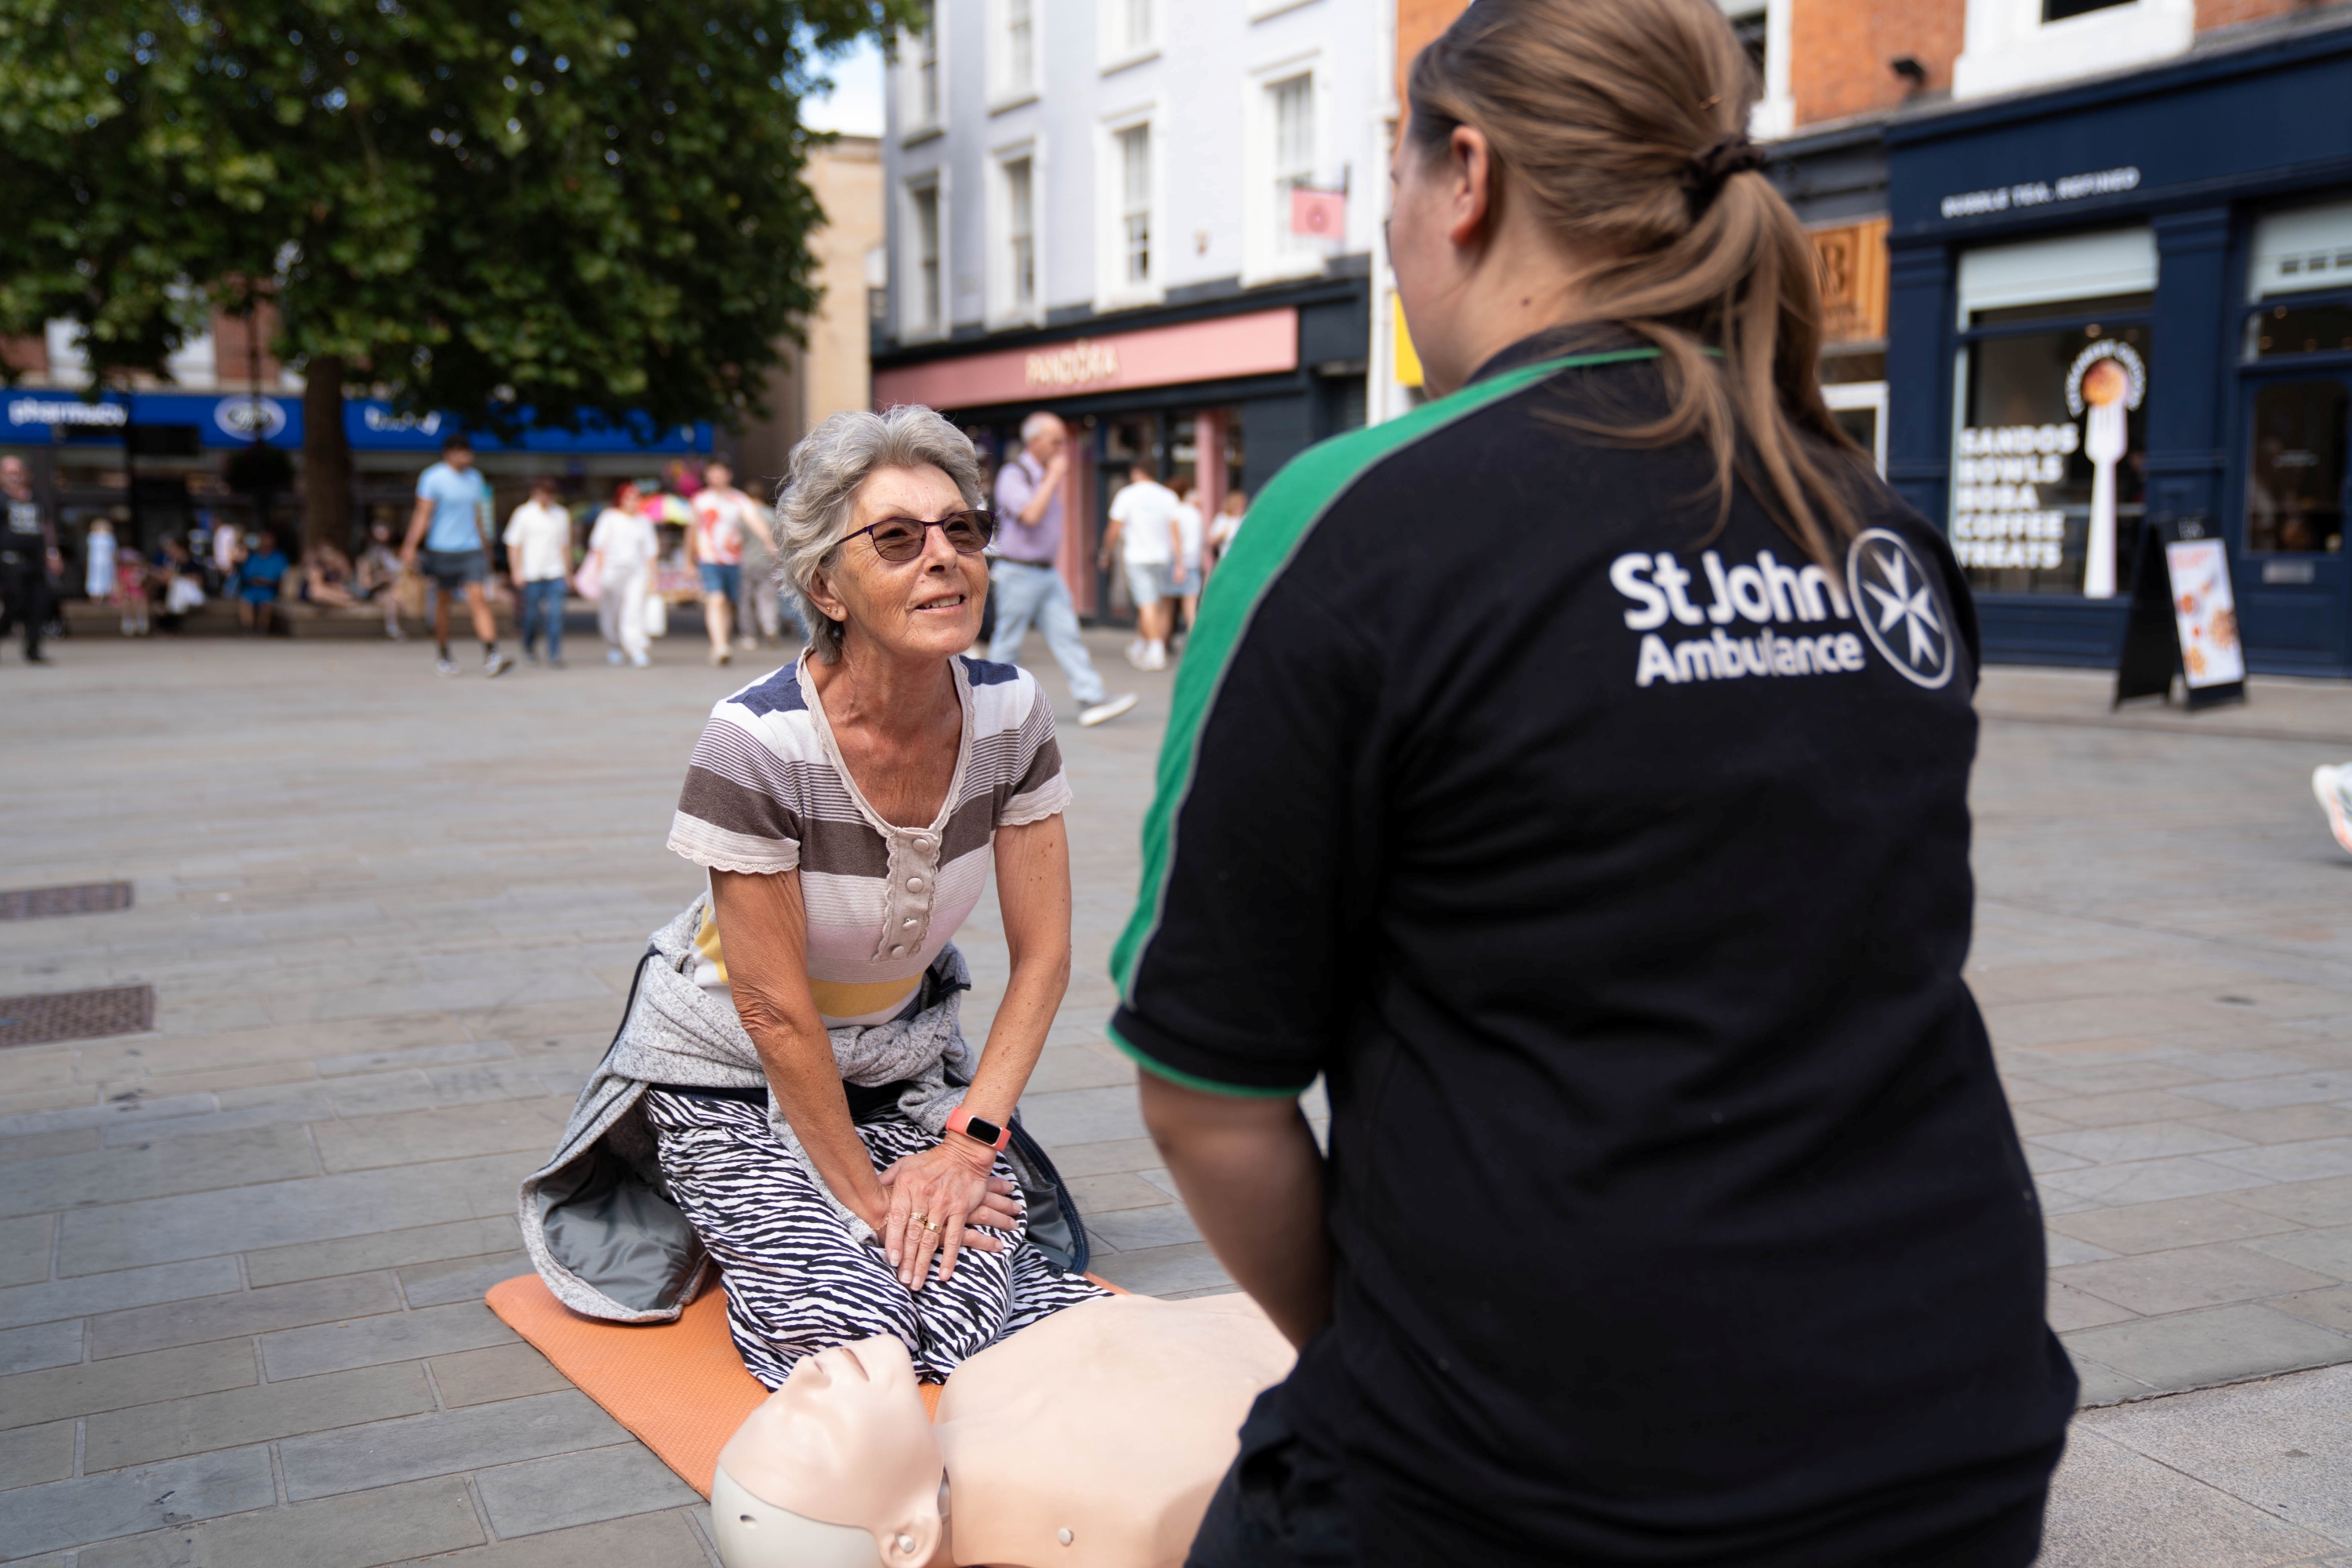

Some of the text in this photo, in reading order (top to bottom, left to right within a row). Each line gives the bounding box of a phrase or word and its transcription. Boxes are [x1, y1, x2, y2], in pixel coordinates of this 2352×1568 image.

[2055, 166, 2141, 200] REFINED
[1025, 342, 1120, 385] PANDORA
[9, 397, 128, 426] pharmacy
[1959, 423, 2079, 456] SANDOS
[1958, 455, 2063, 484] BOWLS
[1956, 485, 2040, 511] BOBA
[1955, 511, 2065, 539] COFFEE
[1955, 541, 2063, 569] TREATS
[1610, 550, 1851, 630] St John
[1635, 627, 1866, 688] Ambulance
